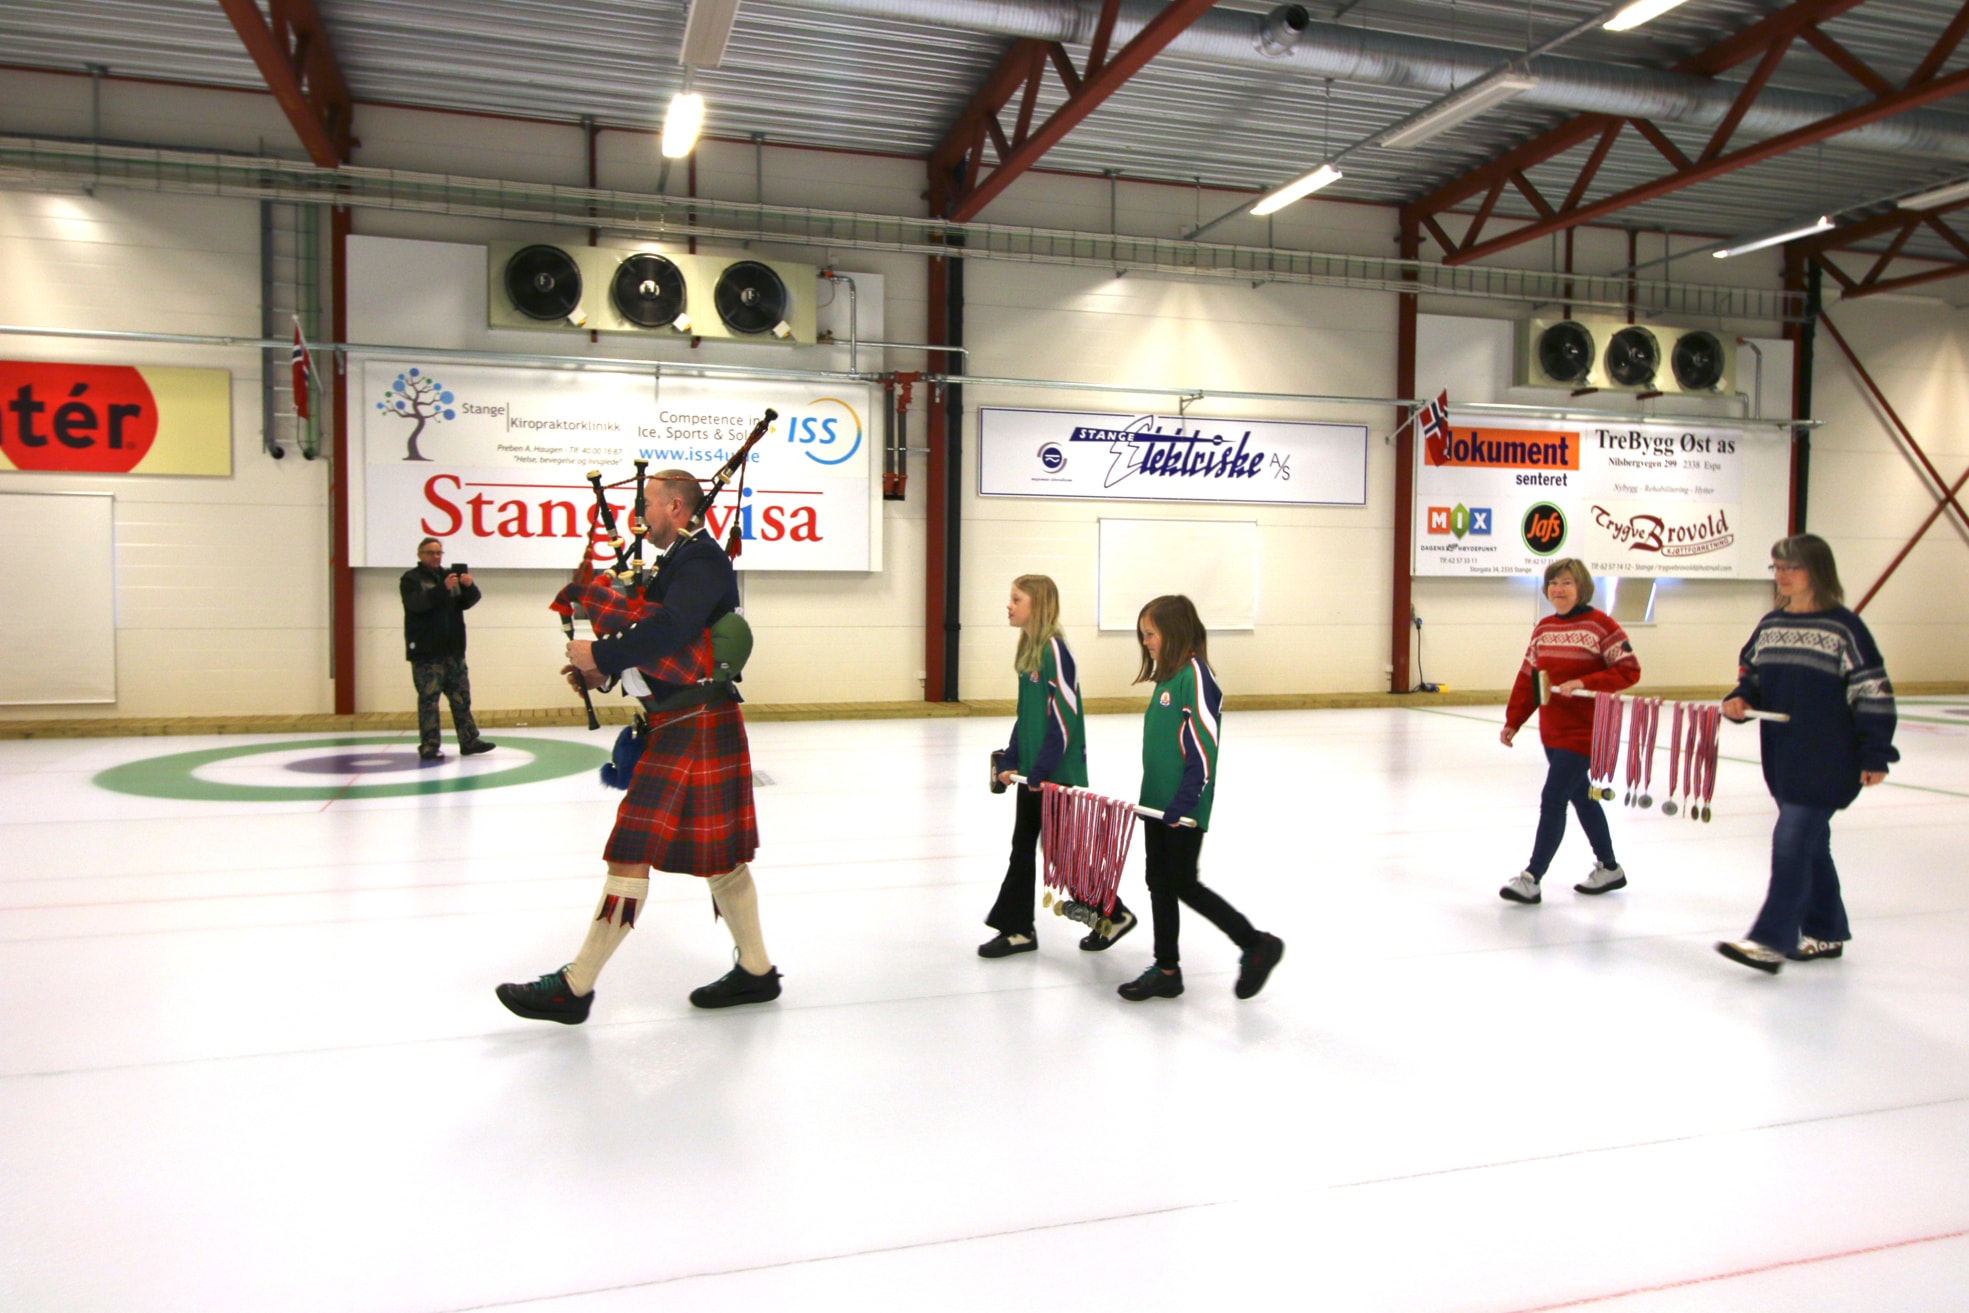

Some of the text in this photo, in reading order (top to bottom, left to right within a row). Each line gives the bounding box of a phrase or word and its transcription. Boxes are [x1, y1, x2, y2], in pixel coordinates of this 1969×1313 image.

[0, 383, 141, 449] tér
[462, 403, 505, 417] Stange
[511, 417, 621, 433] Kiropraktorklinikk
[659, 411, 744, 426] Competence
[638, 426, 661, 439] Ice,
[666, 427, 709, 441] Sports
[714, 429, 724, 441] &
[787, 417, 839, 444] ISS
[1079, 429, 1136, 442] STANGE
[497, 444, 523, 453] Preben
[1595, 429, 1735, 456] TreBygg Øst as
[577, 458, 587, 466] og
[1270, 453, 1291, 481] A/S
[1609, 457, 1662, 469] Nilsbergvegen
[1516, 472, 1568, 487] senteret
[1614, 483, 1638, 494] Nybygg
[421, 473, 824, 562] Stangvisa
[1431, 511, 1488, 531] MIX
[1527, 511, 1561, 543] Jafs
[1591, 505, 1729, 552] Trygve Brovold
